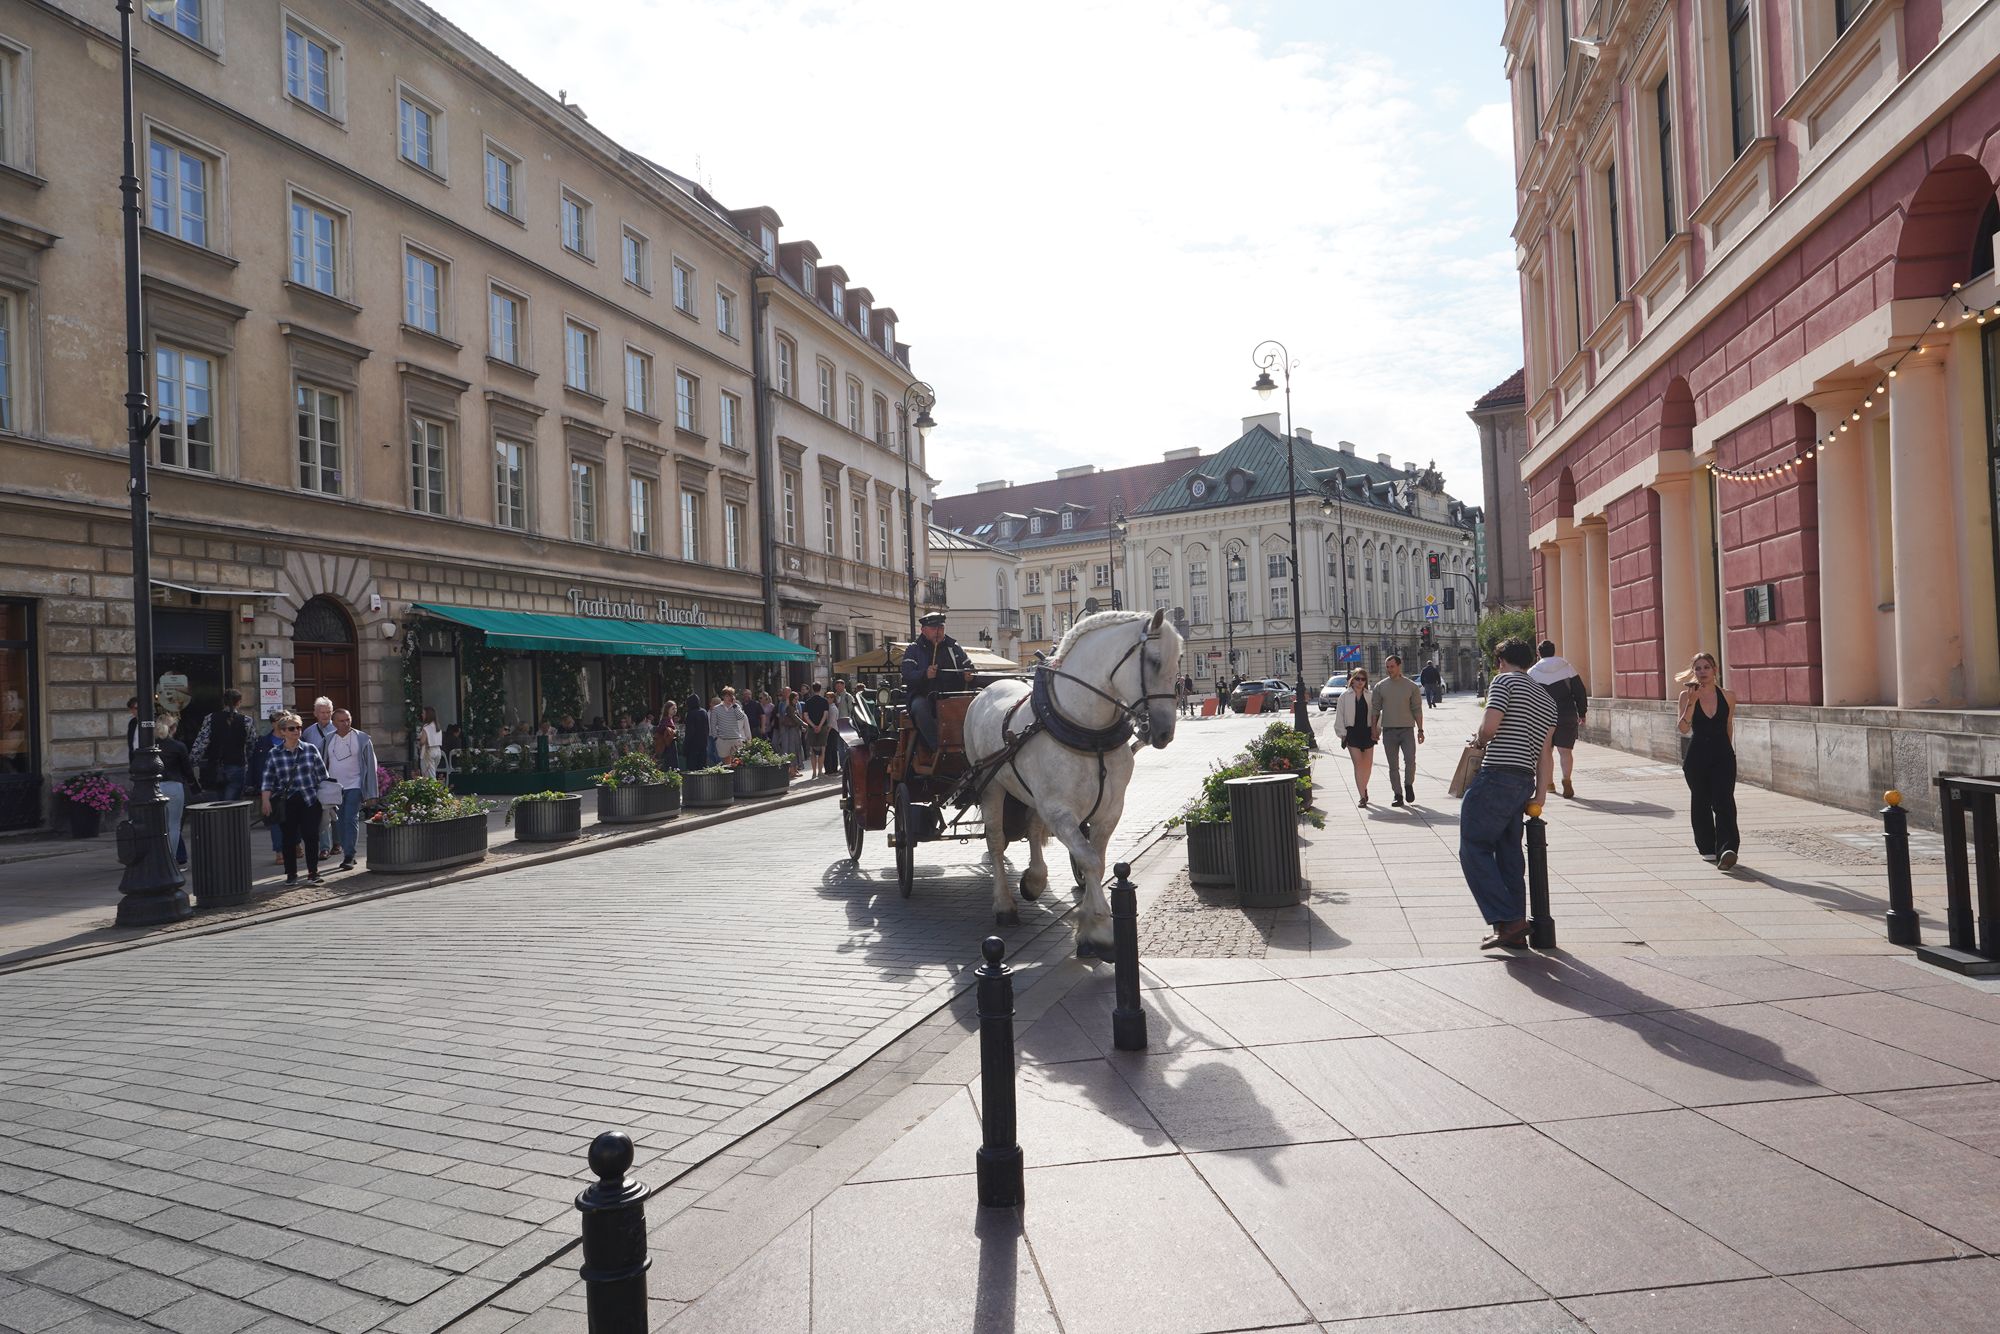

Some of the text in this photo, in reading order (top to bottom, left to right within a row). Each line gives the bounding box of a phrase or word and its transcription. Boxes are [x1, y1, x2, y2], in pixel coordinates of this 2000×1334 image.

[1477, 532, 1487, 575] PTTK
[567, 588, 708, 626] Trattoria Rucola
